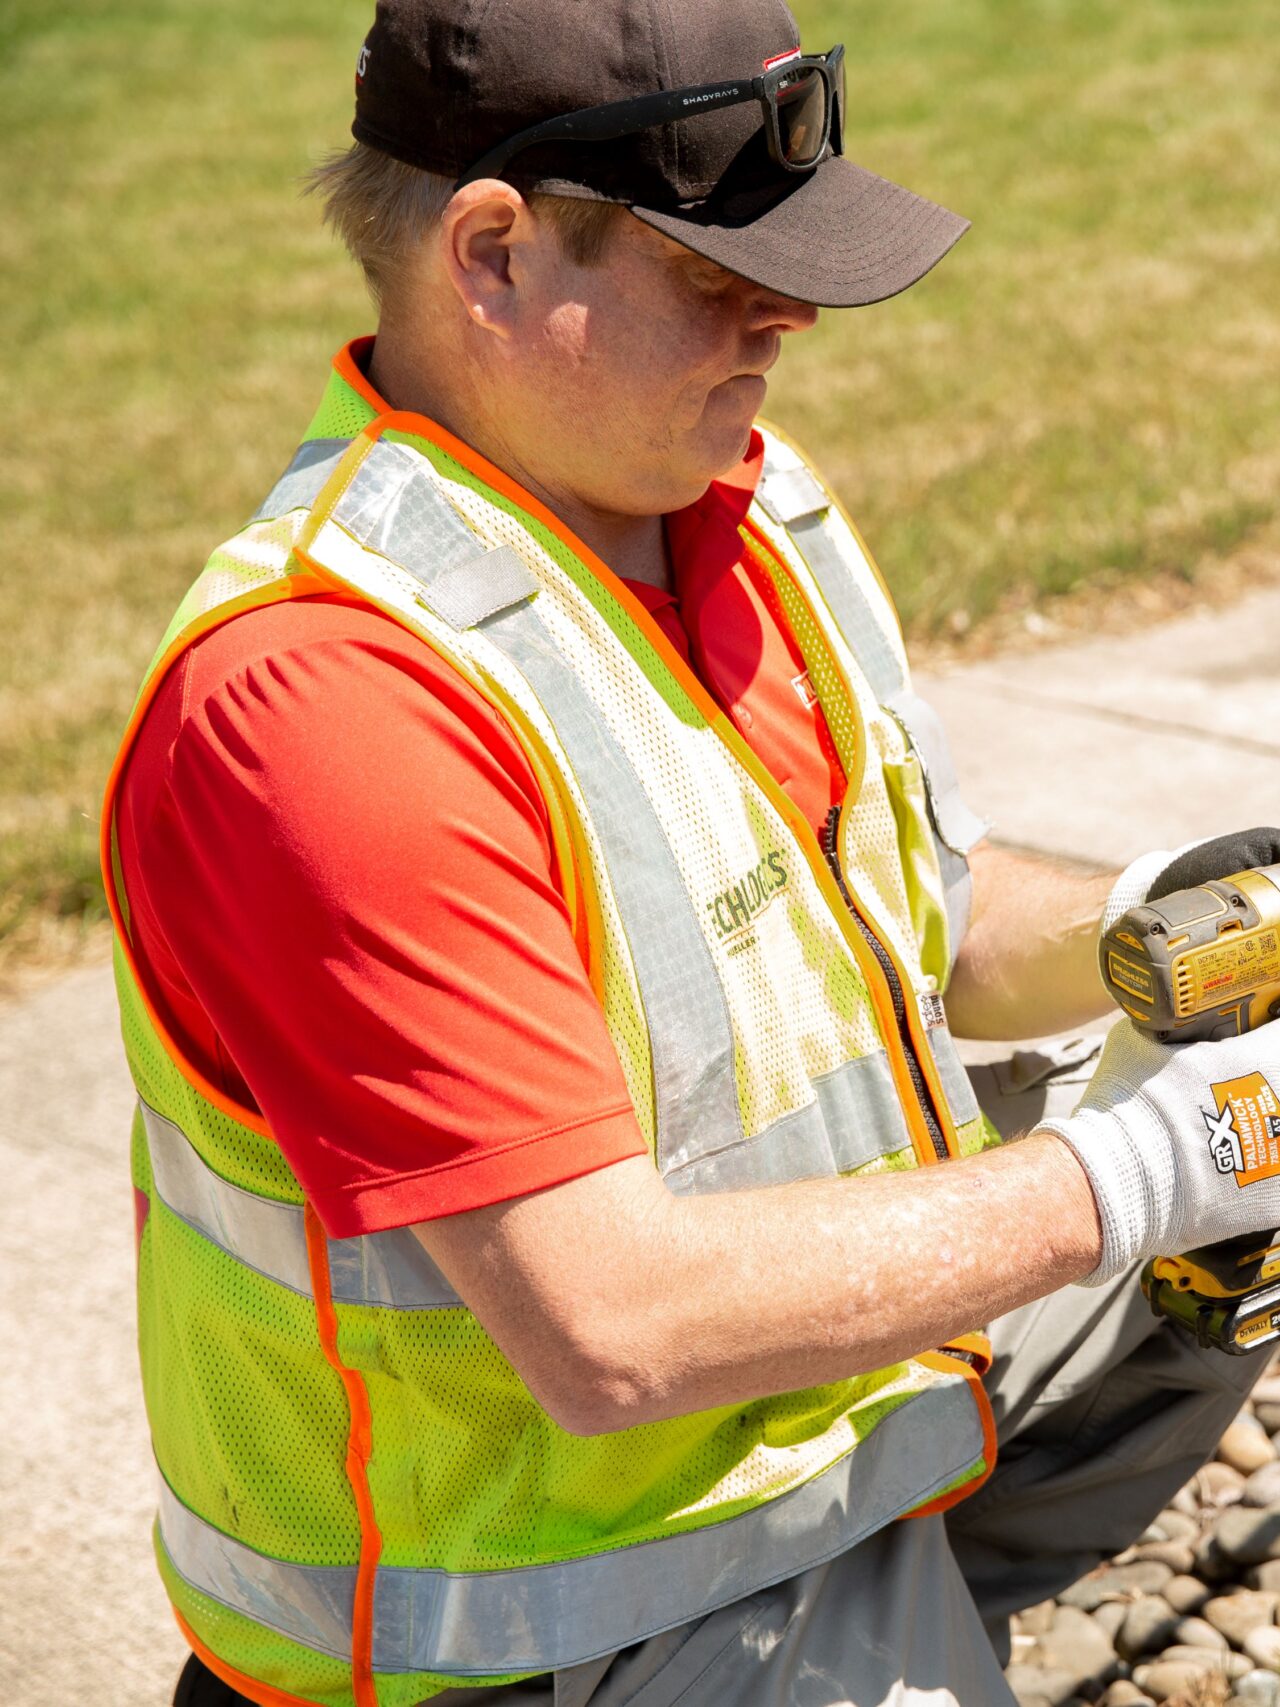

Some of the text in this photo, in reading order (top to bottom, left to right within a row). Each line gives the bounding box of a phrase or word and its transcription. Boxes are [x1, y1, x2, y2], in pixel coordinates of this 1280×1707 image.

[682, 88, 739, 105] SHADYRAYS
[1202, 1100, 1245, 1174] GRX
[1231, 1097, 1258, 1170] PALMWICK
[1244, 1097, 1268, 1166] TECHNOLOGY
